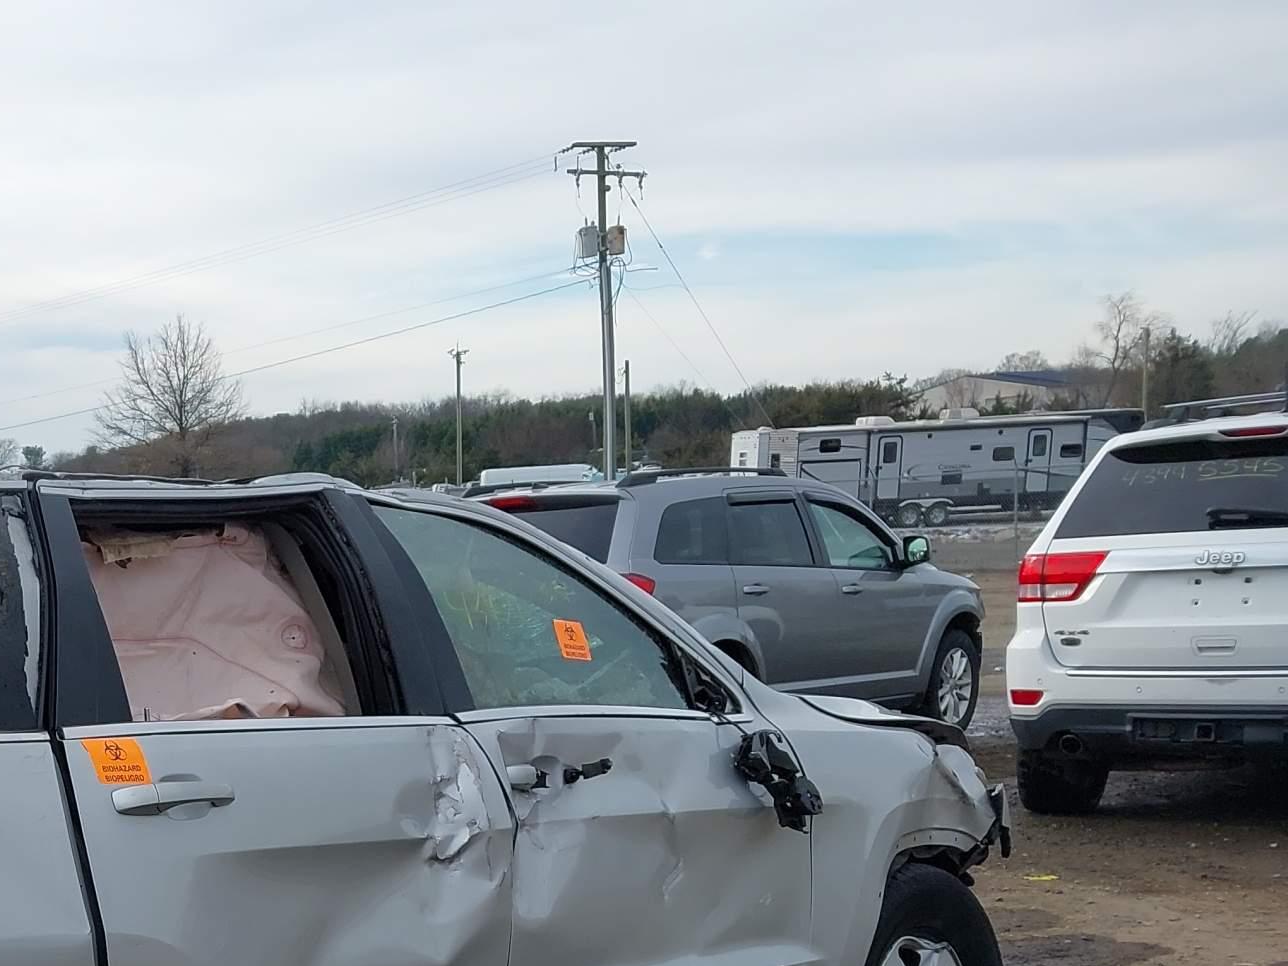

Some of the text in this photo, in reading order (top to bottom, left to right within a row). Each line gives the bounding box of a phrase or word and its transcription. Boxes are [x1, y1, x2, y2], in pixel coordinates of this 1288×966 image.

[1193, 548, 1245, 567] Jeep
[102, 764, 142, 773] BIOHAZARD
[105, 774, 144, 783] BIOPELIGRO
